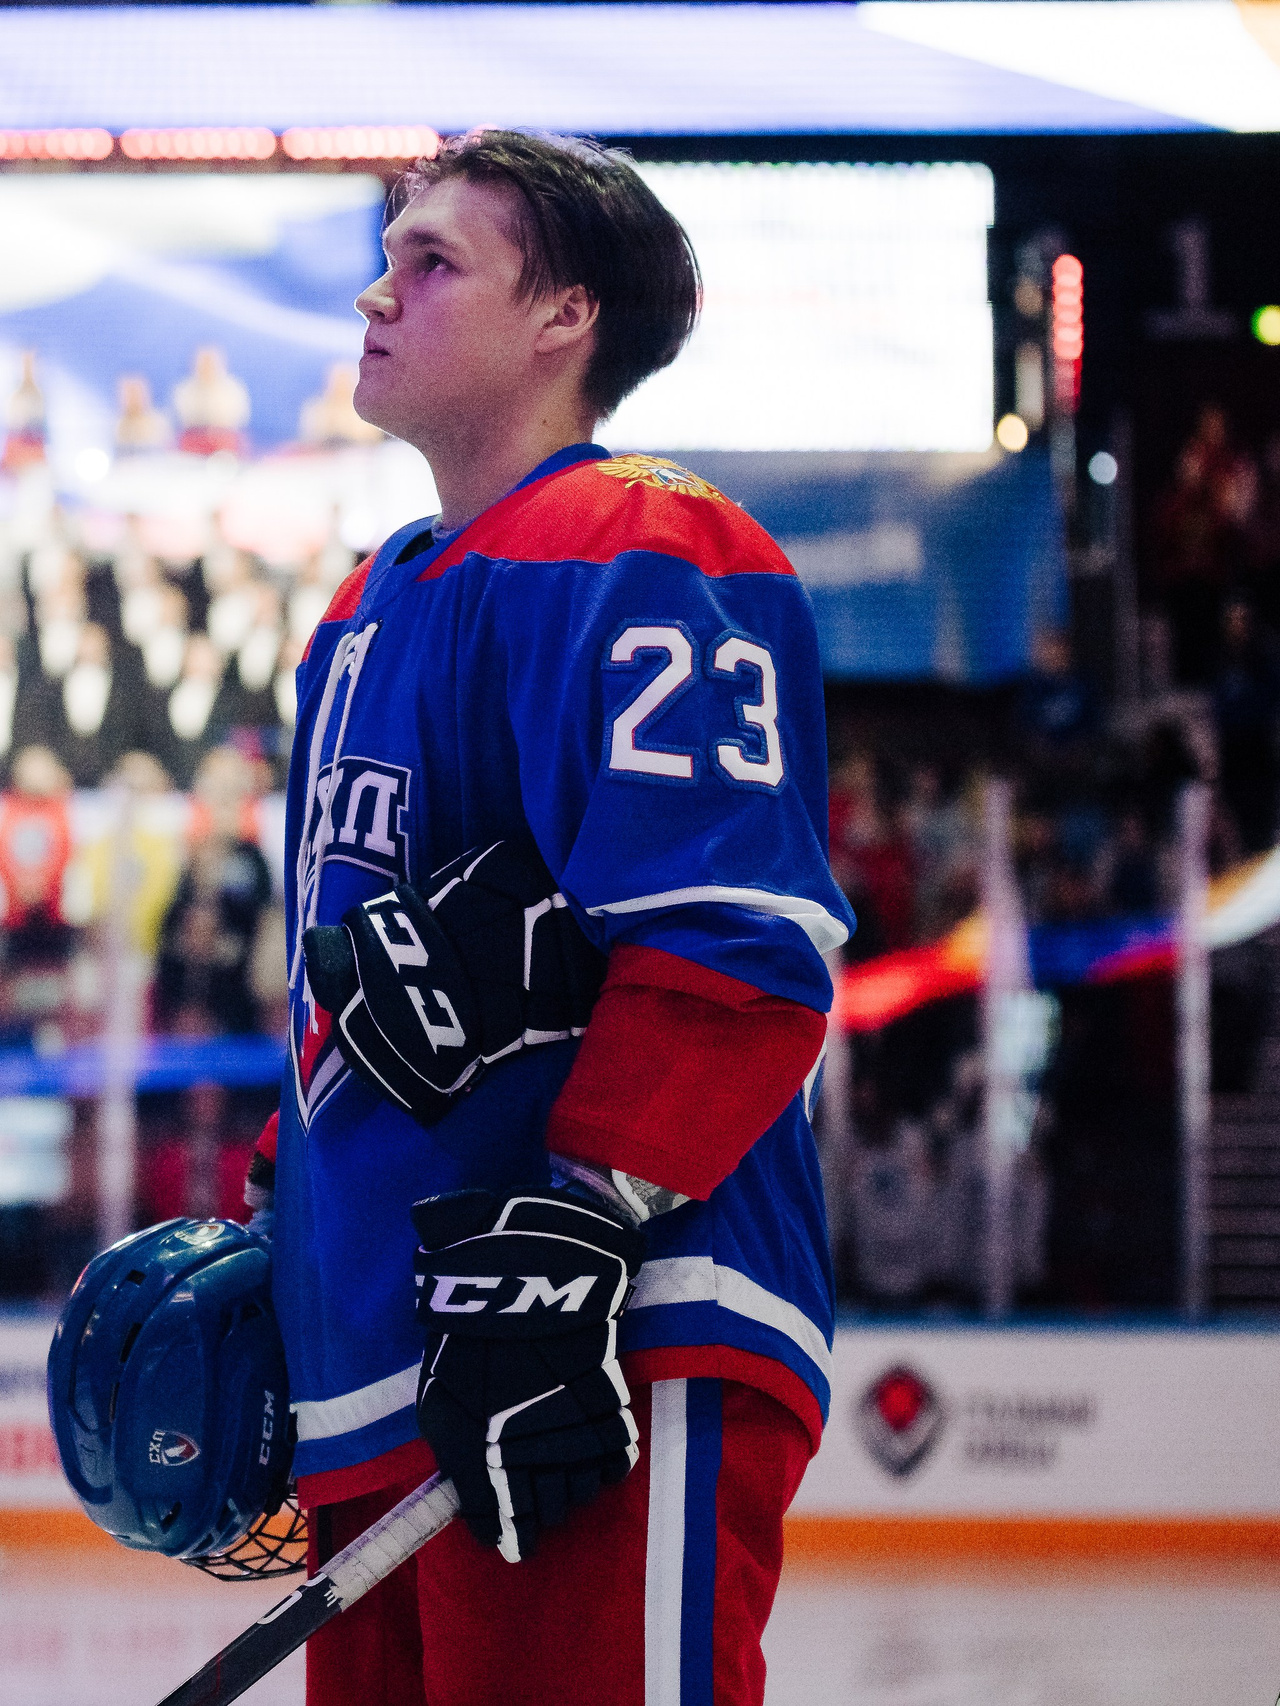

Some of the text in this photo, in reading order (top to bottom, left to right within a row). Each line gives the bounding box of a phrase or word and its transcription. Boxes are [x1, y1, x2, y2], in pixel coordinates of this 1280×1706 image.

[608, 626, 784, 787] 23
[312, 767, 399, 858] ХП
[362, 890, 467, 1055] CC
[415, 1275, 599, 1314] CM
[258, 1388, 275, 1466] CCM
